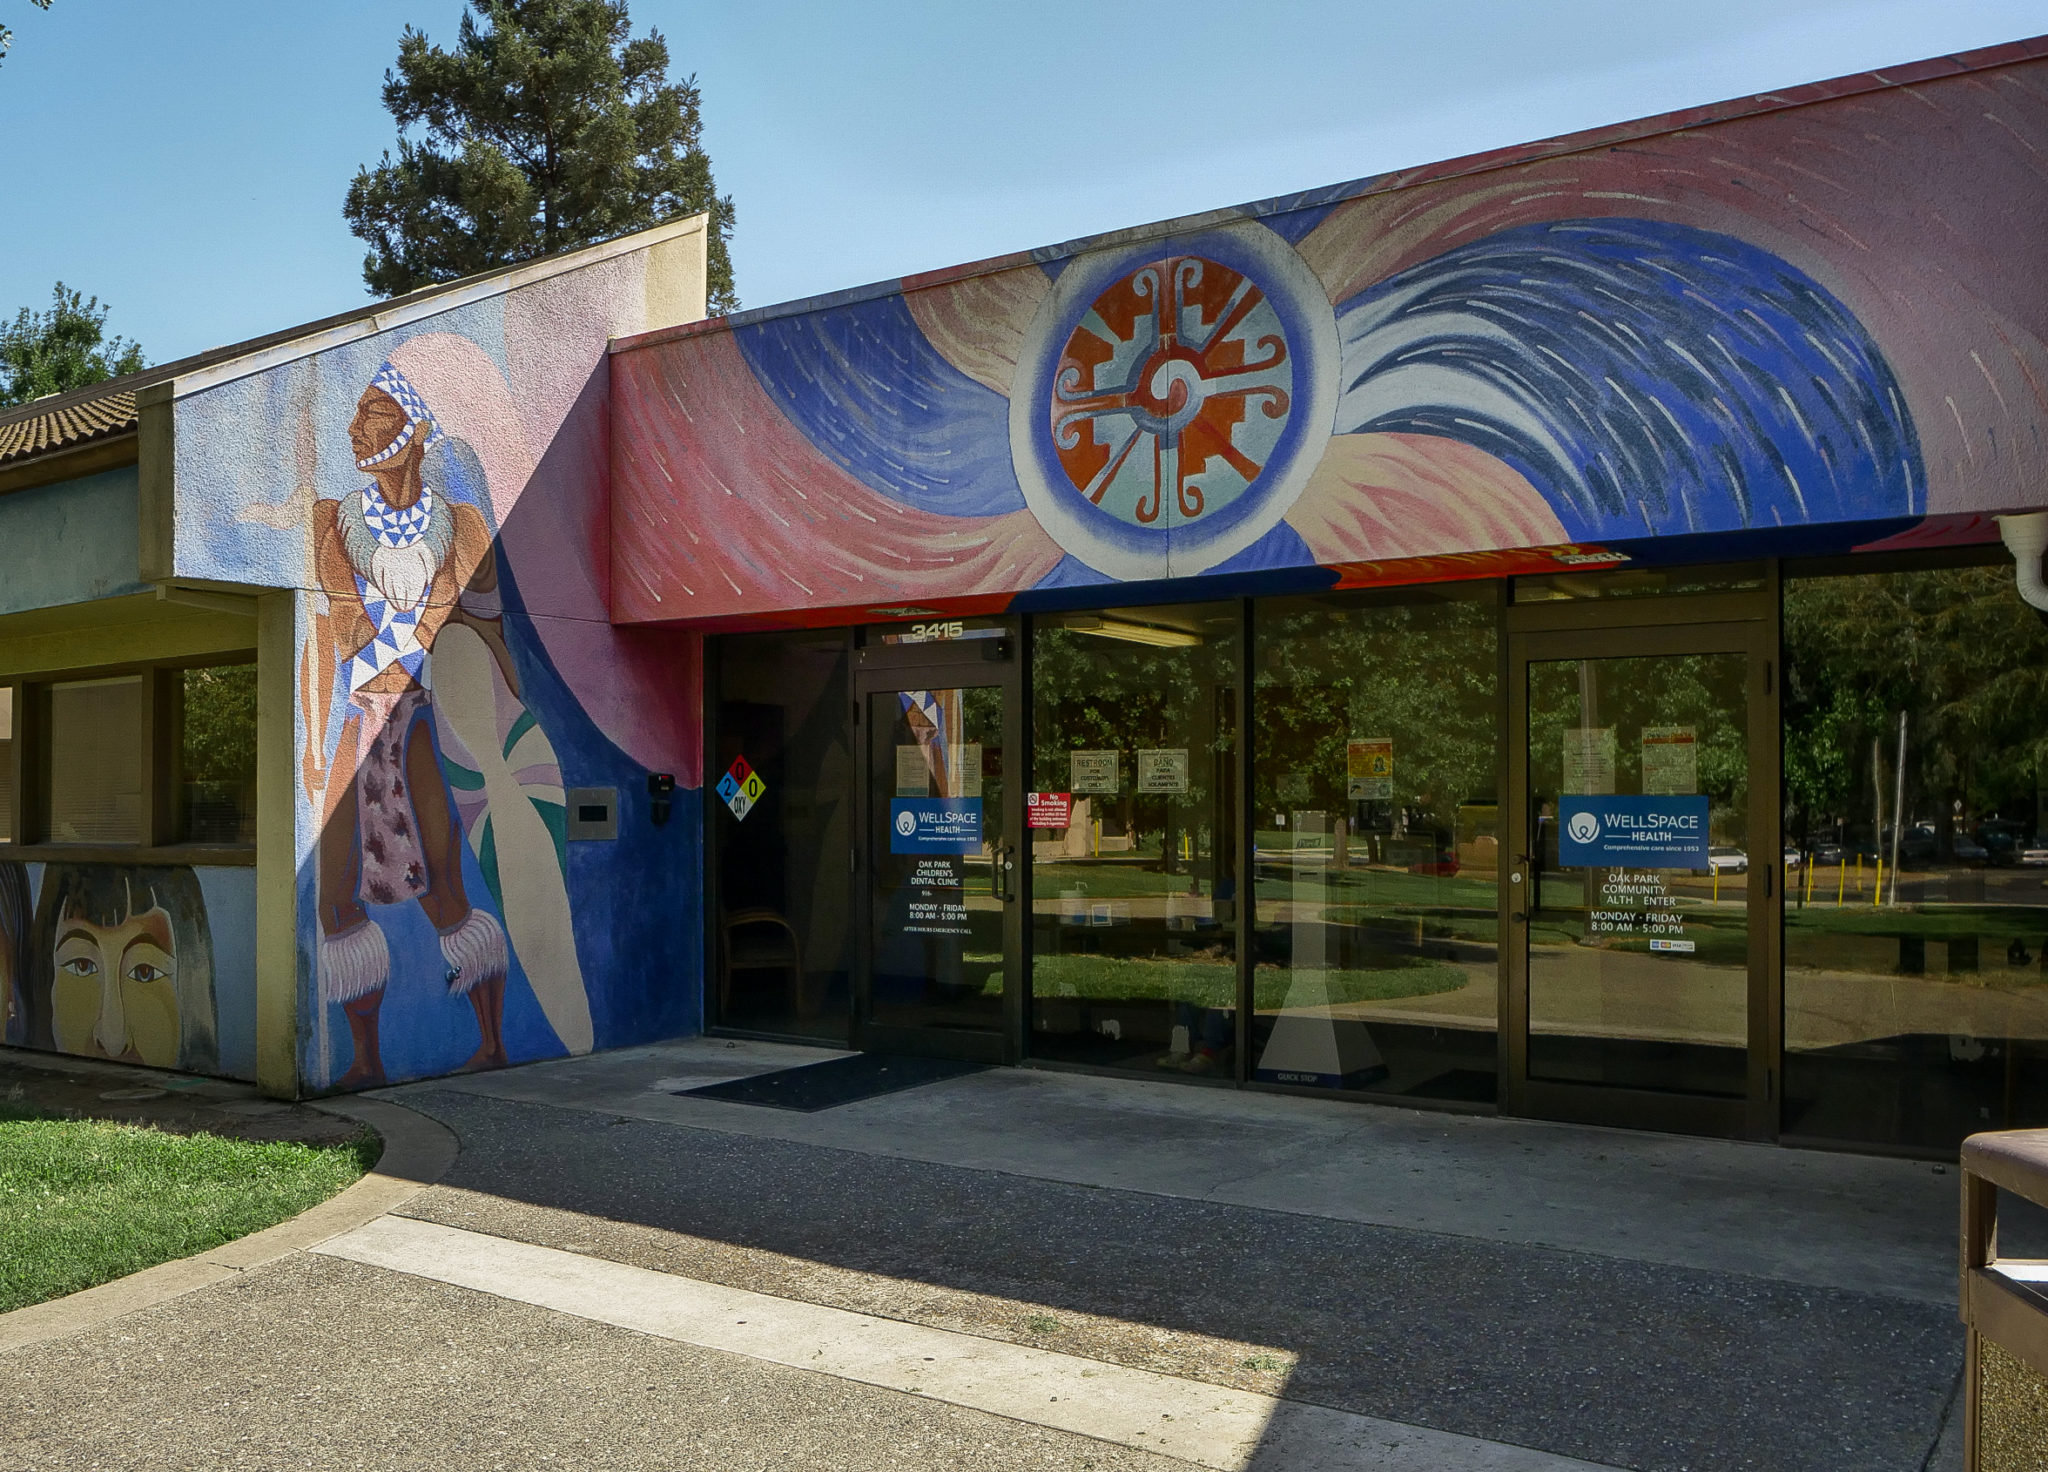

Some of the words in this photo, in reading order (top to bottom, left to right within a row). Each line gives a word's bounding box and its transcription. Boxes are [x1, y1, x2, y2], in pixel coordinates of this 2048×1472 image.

[912, 622, 963, 640] 3415
[1077, 759, 1112, 767] RESTROOM
[736, 762, 744, 780] 0
[724, 778, 731, 796] 2
[749, 779, 757, 797] 0
[734, 796, 746, 814] OXY
[935, 825, 960, 834] HEALTH
[1632, 832, 1672, 841] HEALTH
[1604, 844, 1650, 852] Comprehensive
[919, 860, 932, 868] OAK
[916, 869, 953, 877] CHILDREN'S
[911, 877, 936, 885] DENTAL
[937, 878, 958, 886] CLINIC
[1609, 874, 1630, 883] OAK
[1634, 874, 1660, 884] PARK
[1603, 884, 1666, 895] COMMUNITY
[943, 904, 966, 912] FRIDAY
[941, 912, 956, 920] 5:00
[1591, 911, 1636, 921] MONDAY
[1646, 913, 1683, 923] FRIDAY
[1591, 922, 1614, 931] 8:00
[1616, 923, 1632, 932] AM
[1642, 924, 1665, 933] 5:00
[1668, 925, 1683, 934] PM
[1277, 1073, 1297, 1081] QUICK
[1300, 1074, 1317, 1082] STOP
